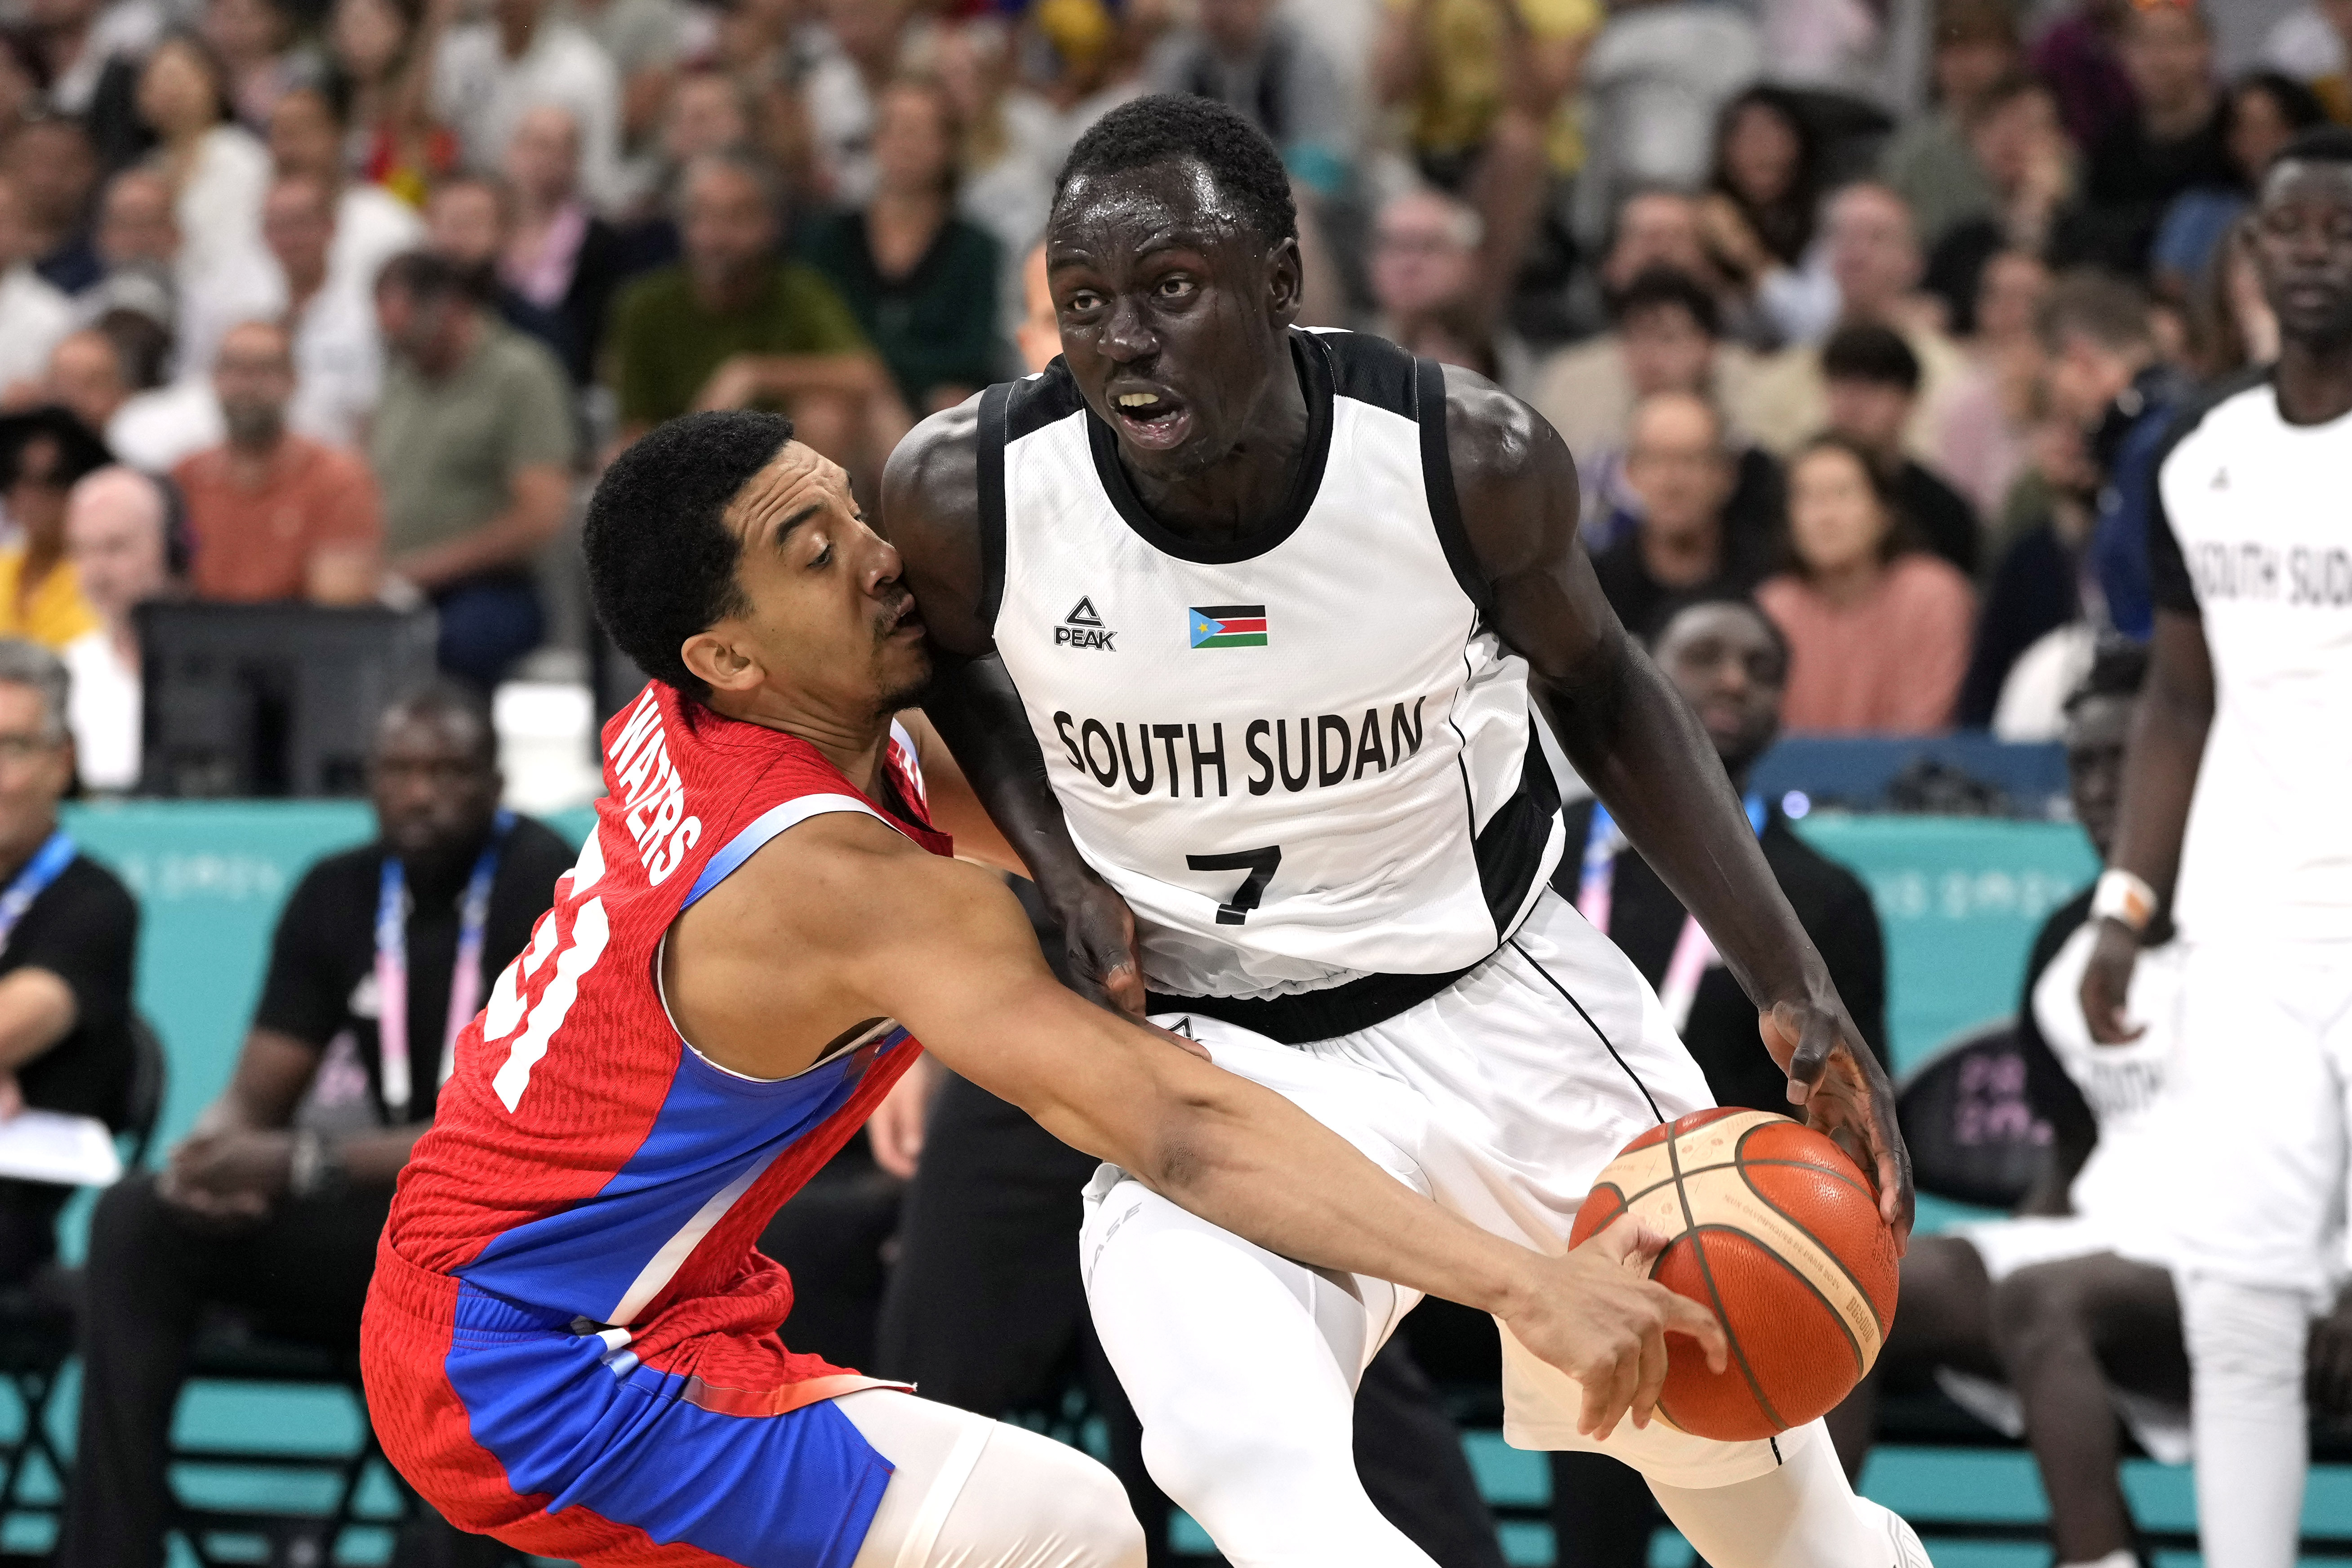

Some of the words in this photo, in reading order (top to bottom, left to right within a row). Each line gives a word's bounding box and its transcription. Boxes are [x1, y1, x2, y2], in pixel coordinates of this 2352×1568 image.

[1054, 626, 1118, 651] PEAK
[608, 687, 702, 886] WATERS
[1053, 710, 1228, 798] SOUTH
[1245, 696, 1428, 796] SUDAN
[1185, 845, 1282, 925] 7
